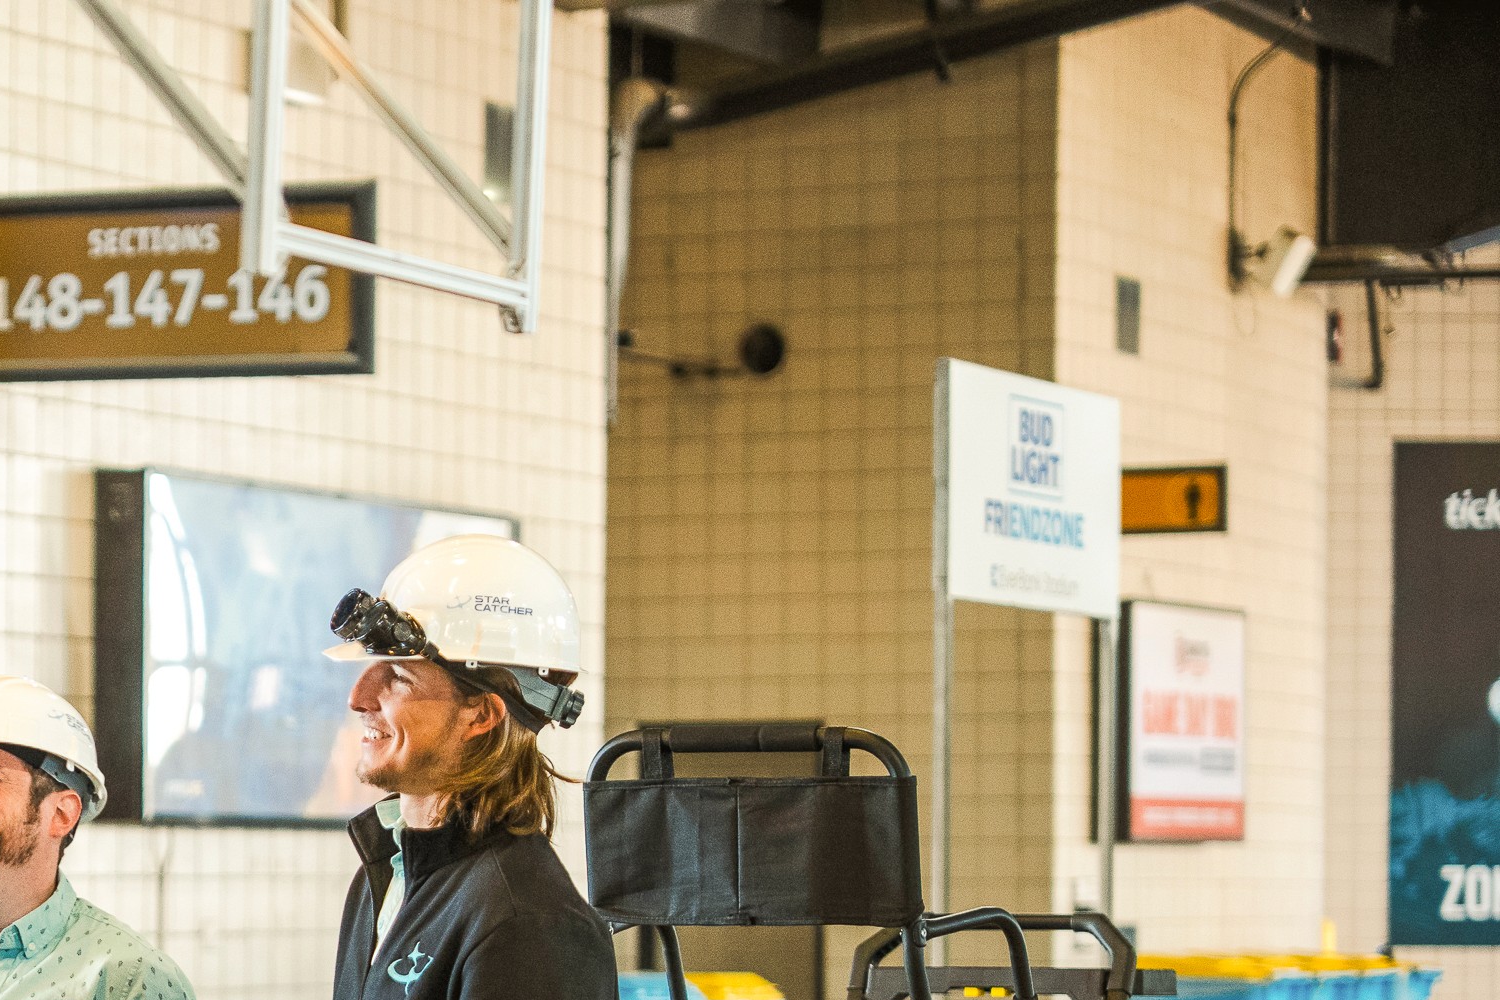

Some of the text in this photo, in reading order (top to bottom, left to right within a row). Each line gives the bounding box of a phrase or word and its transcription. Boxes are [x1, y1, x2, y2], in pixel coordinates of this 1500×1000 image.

[87, 223, 221, 259] SECTIONS
[1018, 408, 1054, 447] BUD
[1011, 445, 1060, 488] LIGHT
[984, 498, 1085, 549] FRIENDZONE
[474, 594, 510, 605] STAR
[474, 603, 534, 616] CATCHER
